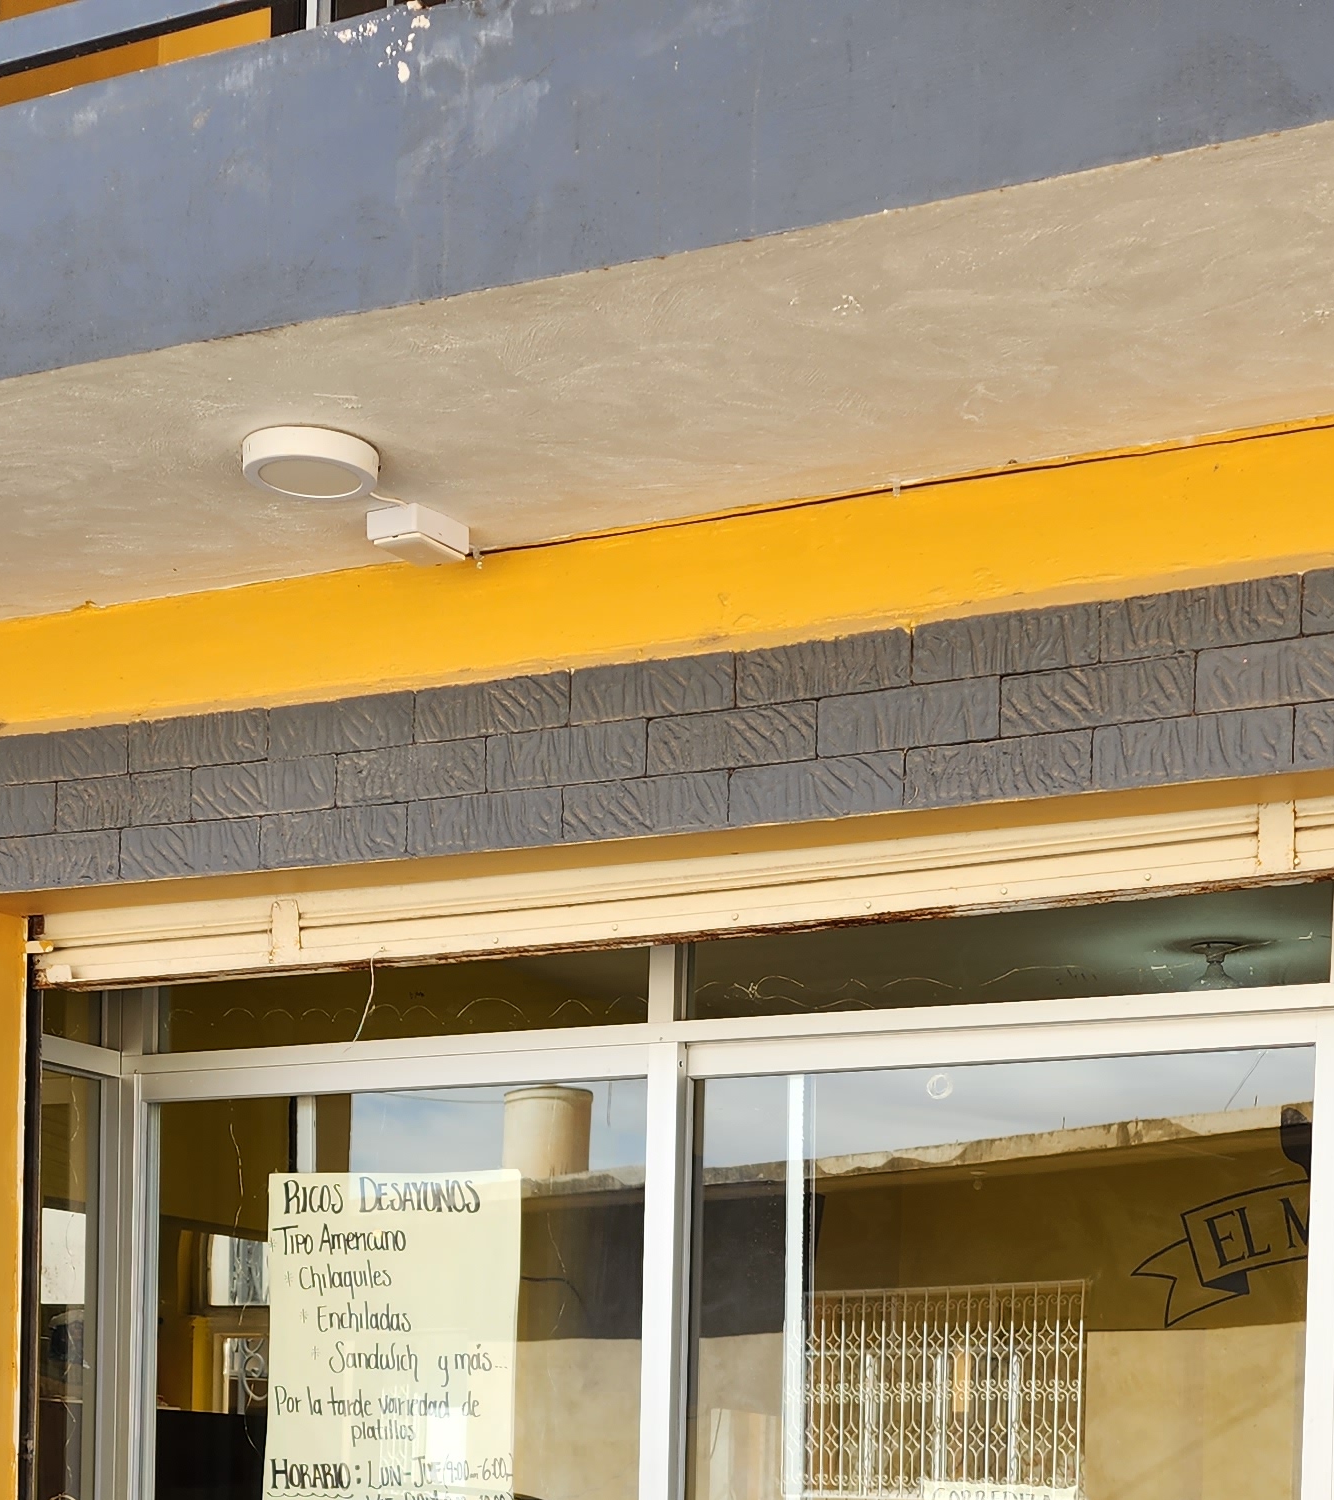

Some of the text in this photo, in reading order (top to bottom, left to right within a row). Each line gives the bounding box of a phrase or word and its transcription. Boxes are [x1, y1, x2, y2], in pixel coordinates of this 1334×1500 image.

[283, 1176, 481, 1215] RICOS DESAYUNOS
[318, 1223, 407, 1255] Americano
[1203, 1206, 1271, 1268] EL
[298, 1259, 393, 1299] Chilaquiles
[316, 1301, 412, 1333] Enchiladas
[328, 1340, 419, 1382] Sandwich
[437, 1353, 450, 1388] y
[274, 1385, 481, 1418] Por la tarde variedad de
[350, 1418, 416, 1448] platillos
